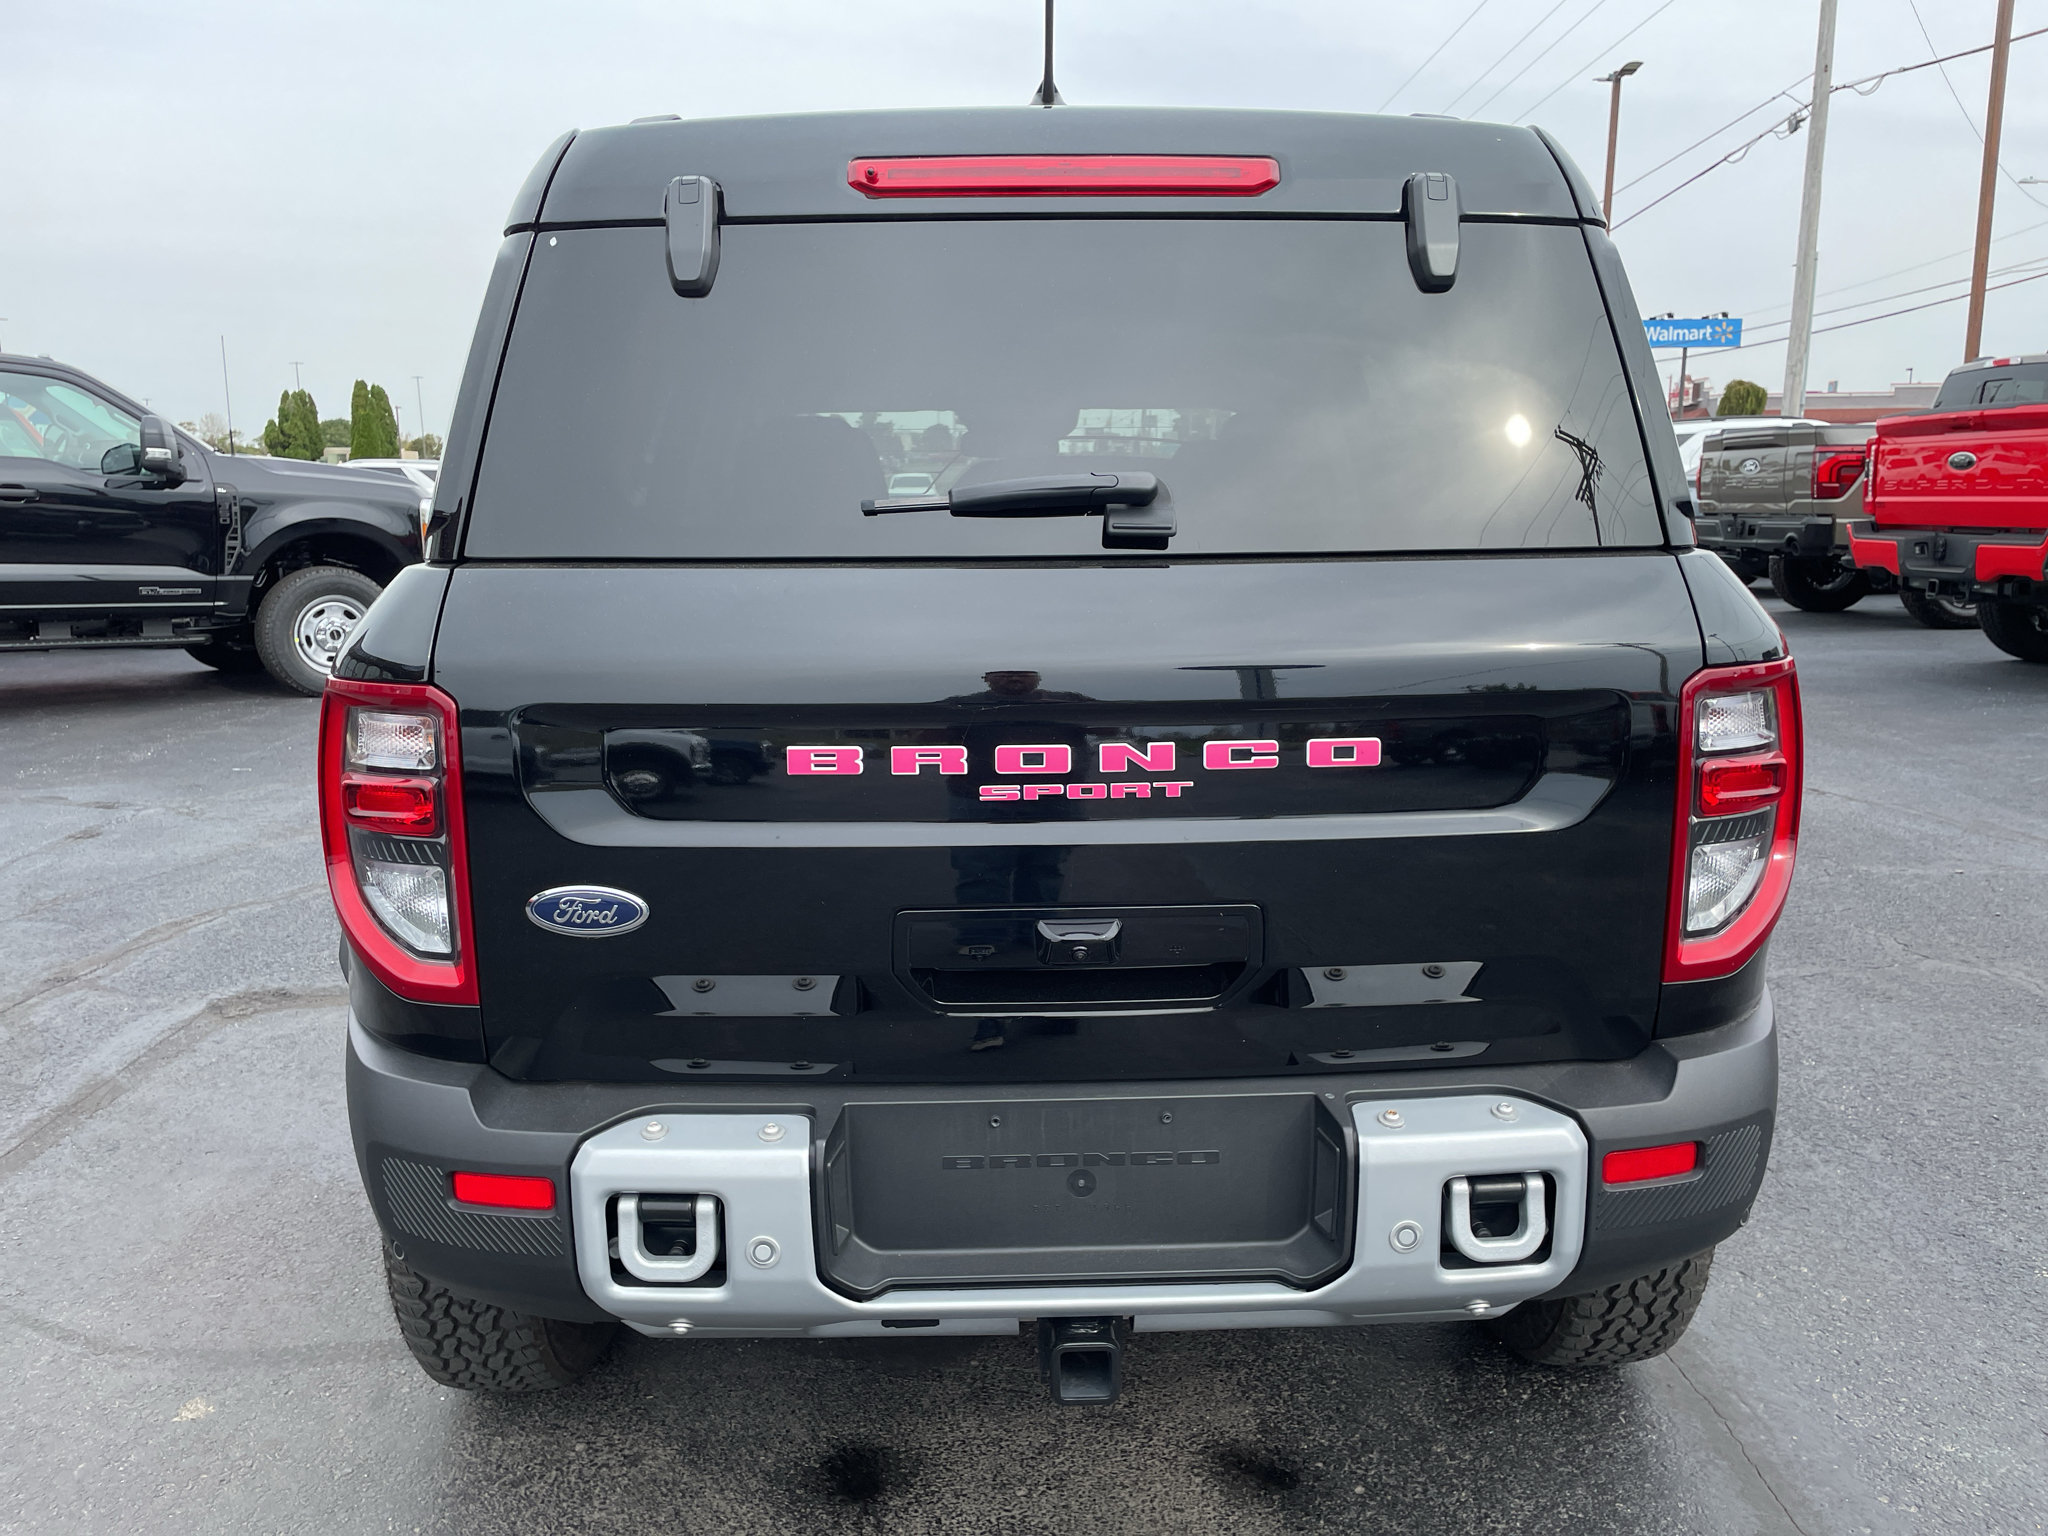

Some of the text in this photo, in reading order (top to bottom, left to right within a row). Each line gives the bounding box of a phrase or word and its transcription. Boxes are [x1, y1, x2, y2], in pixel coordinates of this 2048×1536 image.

[1644, 325, 1712, 342] Walmart
[1884, 479, 1968, 491] SUPER
[787, 737, 1382, 776] BRONCO
[979, 781, 1194, 802] SPORT
[553, 896, 618, 924] Ford
[942, 1149, 1220, 1169] BRONCO
